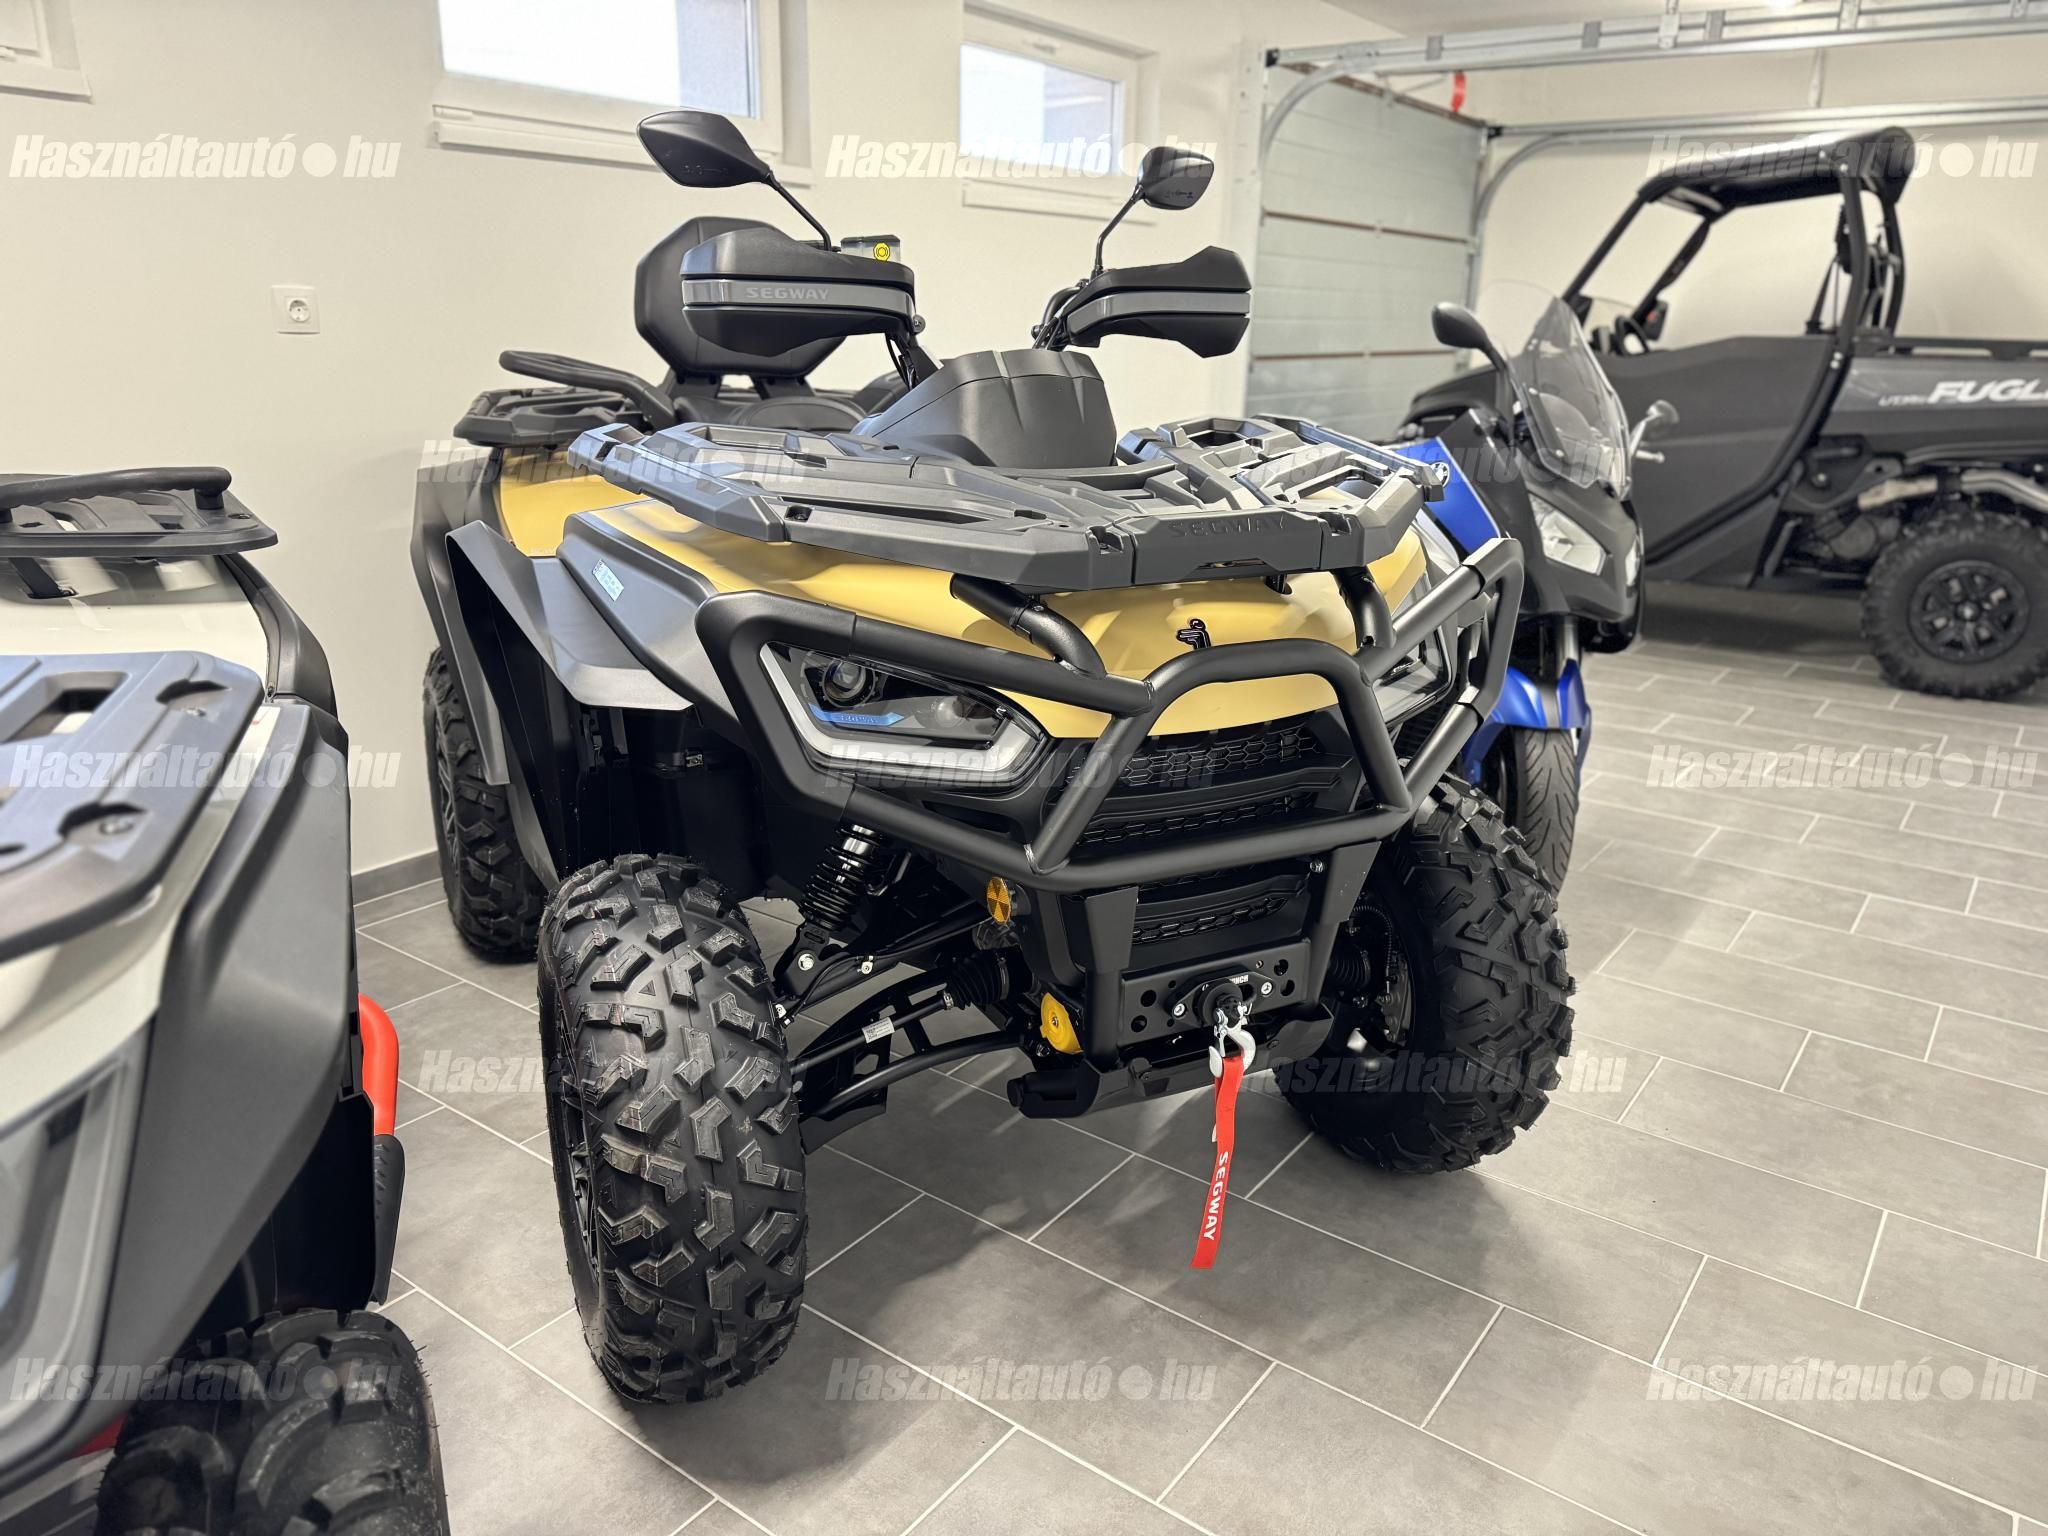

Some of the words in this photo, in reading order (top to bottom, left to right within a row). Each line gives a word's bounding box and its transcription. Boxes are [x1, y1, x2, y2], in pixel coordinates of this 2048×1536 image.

[746, 287, 829, 300] SEGWAY
[1927, 378, 2048, 404] FUGL
[1203, 1151, 1229, 1241] SEGWAY
